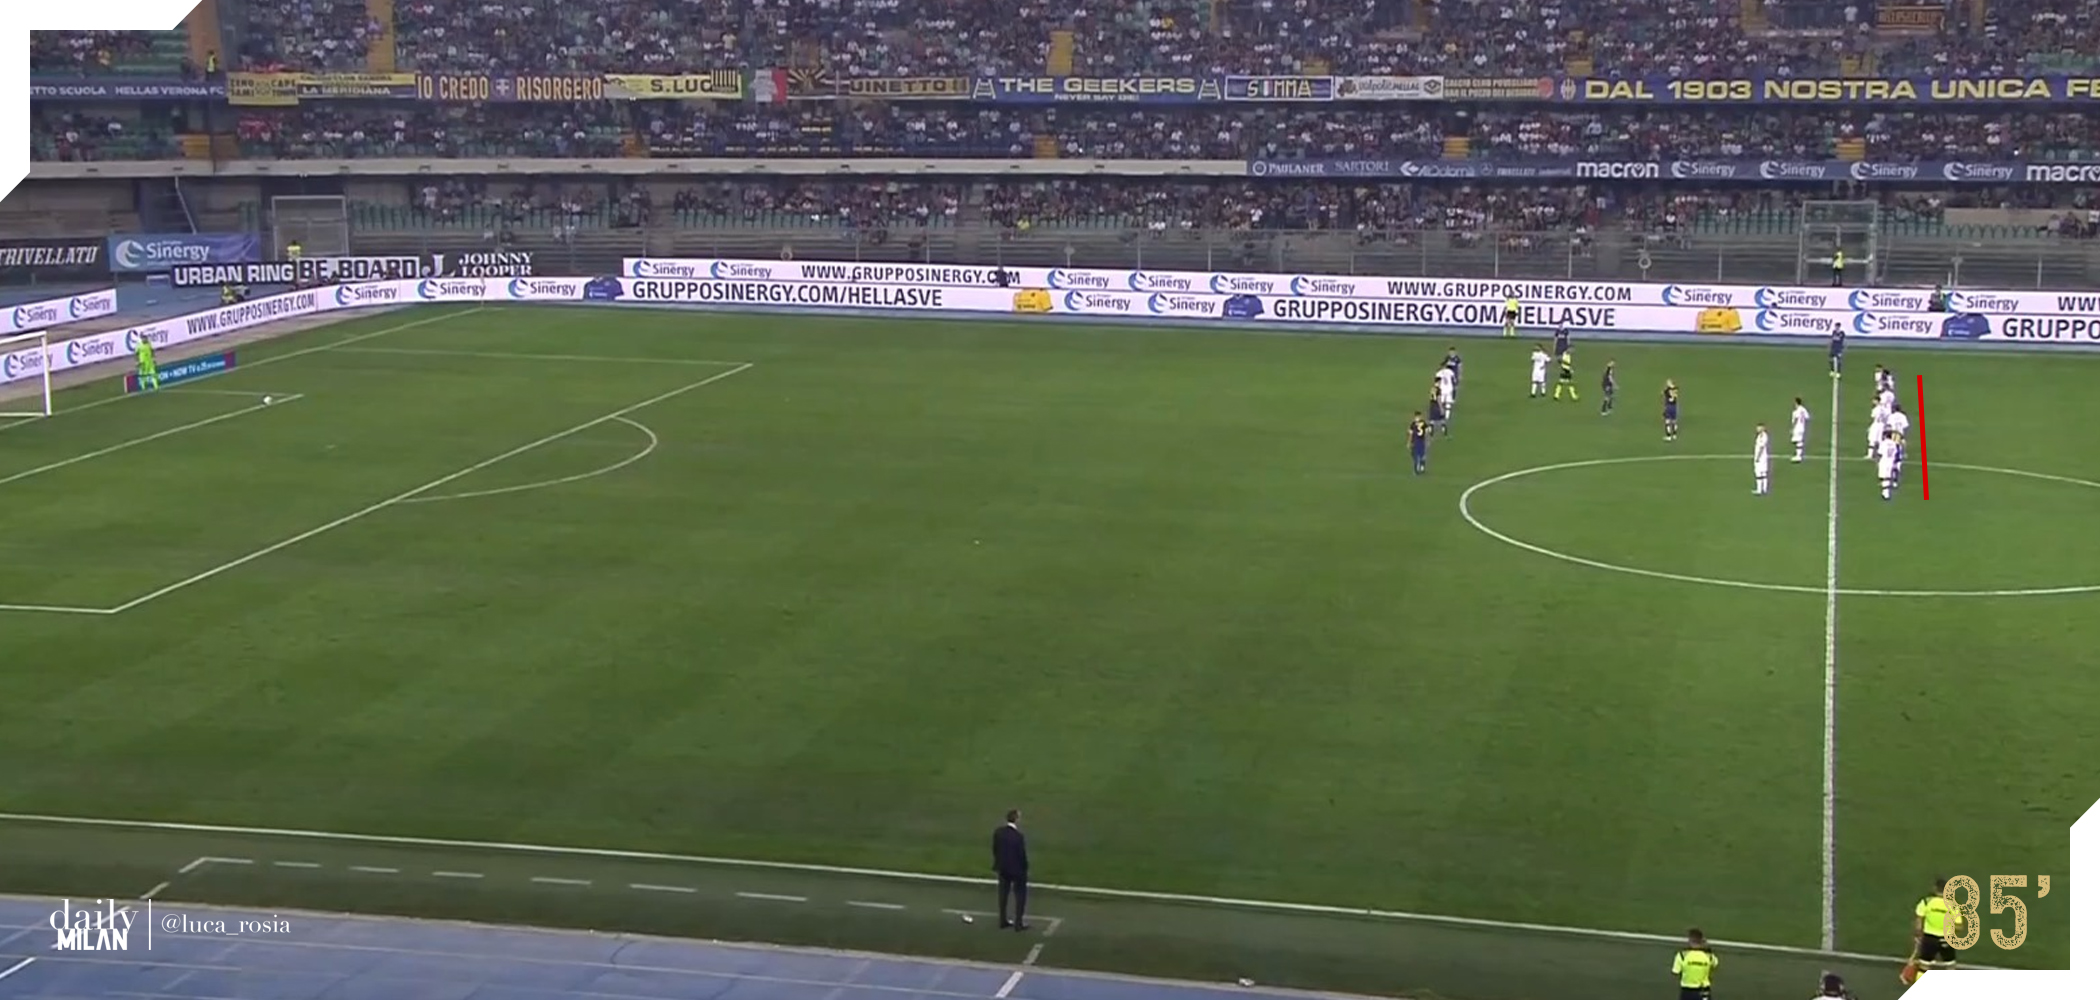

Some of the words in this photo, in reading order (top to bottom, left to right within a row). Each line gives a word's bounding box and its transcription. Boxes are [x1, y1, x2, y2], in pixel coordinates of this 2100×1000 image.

[302, 86, 319, 94] LA
[322, 86, 391, 95] MERIDIANA
[417, 75, 433, 99] IO
[439, 75, 490, 100] CREDO
[516, 76, 602, 100] RISORGERO
[999, 78, 1054, 92] THE
[1063, 78, 1196, 93] GEEKERS
[1472, 78, 1492, 87] CLUB
[1585, 80, 1653, 99] DAL
[1667, 80, 1752, 99] 1903
[1764, 79, 1917, 99] NOSTRA
[1930, 79, 2052, 98] UNICA
[59, 86, 107, 96] SCUOLA
[115, 86, 159, 96] HELLAS
[161, 86, 208, 97] VERONA
[209, 87, 225, 96] FC
[1268, 164, 1324, 175] PAULANER
[1334, 161, 1390, 173] SARTORI
[1576, 161, 1659, 178] macron
[1691, 161, 1736, 177] Sinergy
[1780, 161, 1826, 177] Sinergy
[1871, 163, 1918, 179] Sinergy
[1965, 164, 2013, 180] Sinergy
[0, 246, 98, 266] TRIVELLATO
[146, 243, 210, 261] Sinergy
[458, 251, 533, 265] JOHNNY
[174, 266, 242, 286] URBAN
[247, 264, 295, 283] RING
[301, 259, 328, 280] BE
[339, 260, 417, 279] BOARD
[460, 265, 533, 277] LOOPER
[652, 263, 695, 278] Sinergy
[730, 264, 772, 279] Sinergy
[801, 265, 1021, 285] WWW.GRUPPOSINERGY.CM
[1066, 272, 1110, 289] Sinergy
[1148, 274, 1192, 290] Sinergy
[1230, 276, 1275, 293] Sinergy
[1311, 280, 1356, 295] Sinergy
[354, 286, 397, 301] Sinergy
[440, 283, 487, 298] Sinergy
[530, 283, 577, 298] Sinergy
[632, 281, 943, 307] GRUPPOSINERGY.COM/HELLASVE
[1387, 281, 1632, 302] WWW.GRUPPOSINERGY.COM
[1684, 289, 1733, 305] Sinergy
[83, 297, 111, 313] Sinergy
[1085, 295, 1131, 313] Sinergy
[1169, 296, 1216, 314] Sinergy
[1777, 291, 1827, 307] Sinergy
[1872, 293, 1923, 309] Sinergy
[1966, 296, 2019, 313] Sinergy
[2057, 296, 2100, 312] WW
[27, 306, 58, 322] Sinergy
[186, 292, 315, 336] WWW.GRUPPOSINERGY.COM
[1779, 314, 1833, 332] Sinergy
[1878, 316, 1933, 334] Sinergy
[81, 341, 115, 358] Sinergy
